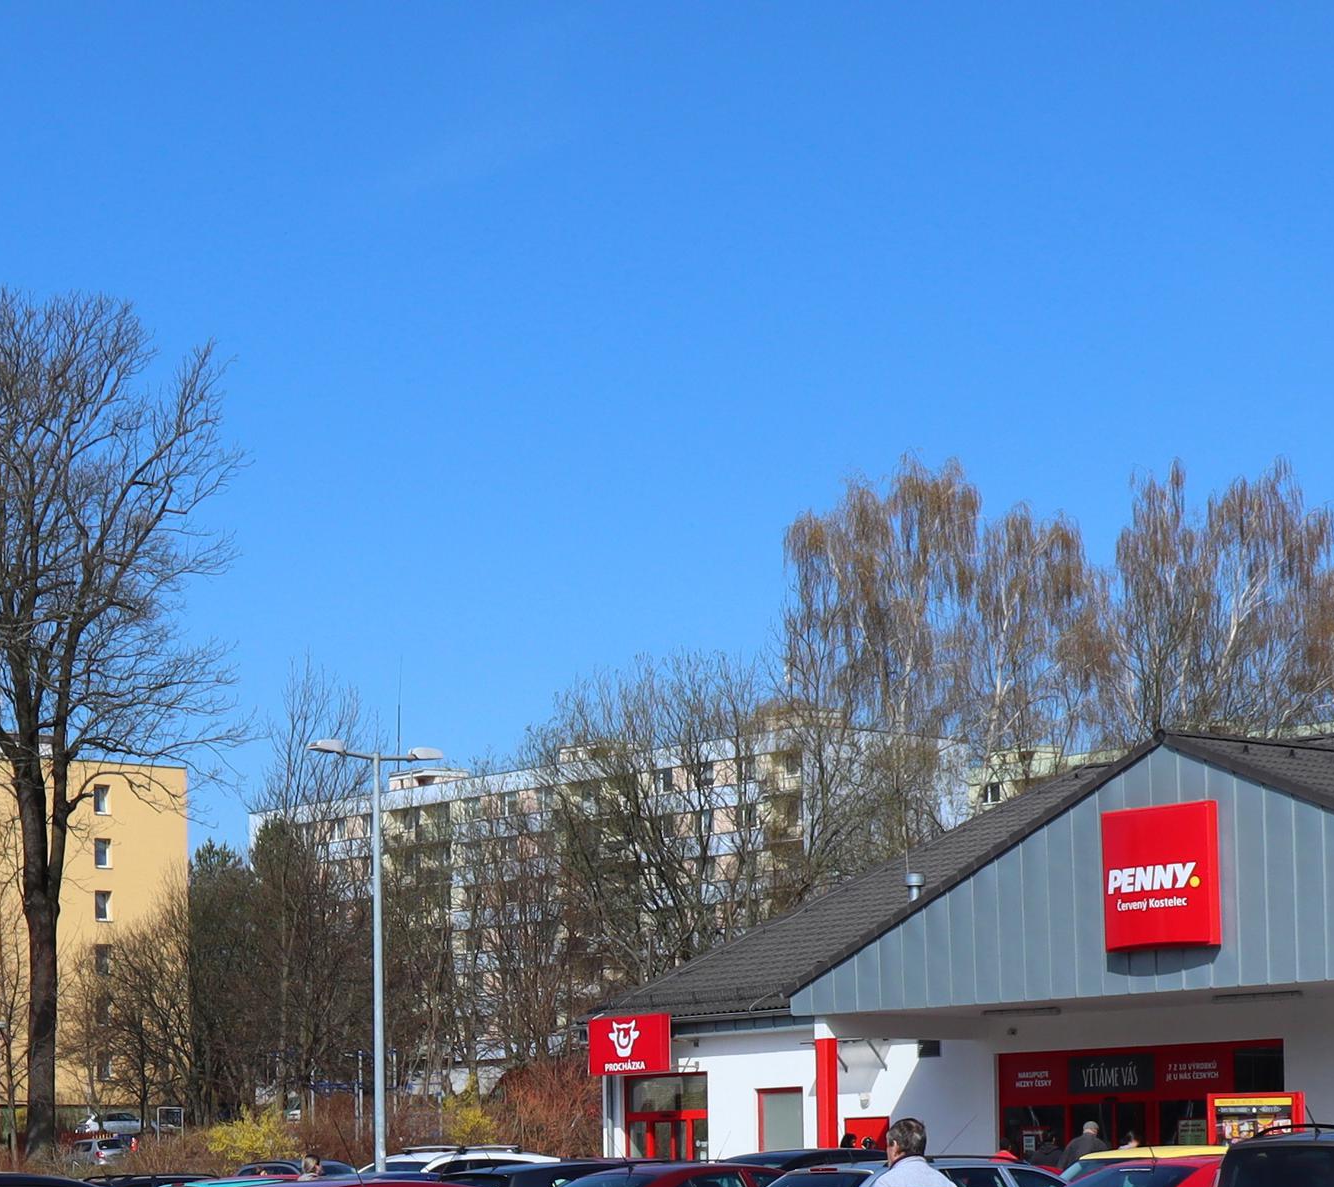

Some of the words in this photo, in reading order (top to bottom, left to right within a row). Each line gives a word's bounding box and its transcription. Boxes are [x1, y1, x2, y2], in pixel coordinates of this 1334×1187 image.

[1117, 898, 1147, 912] Červený
[1149, 896, 1187, 908] Kostelec
[604, 1059, 645, 1072] PROCHÁZKA
[1082, 1063, 1119, 1088] VÍTÁME
[1122, 1061, 1138, 1086] VÁS
[1173, 1073, 1178, 1081] U
[1178, 1071, 1192, 1080] NÁS
